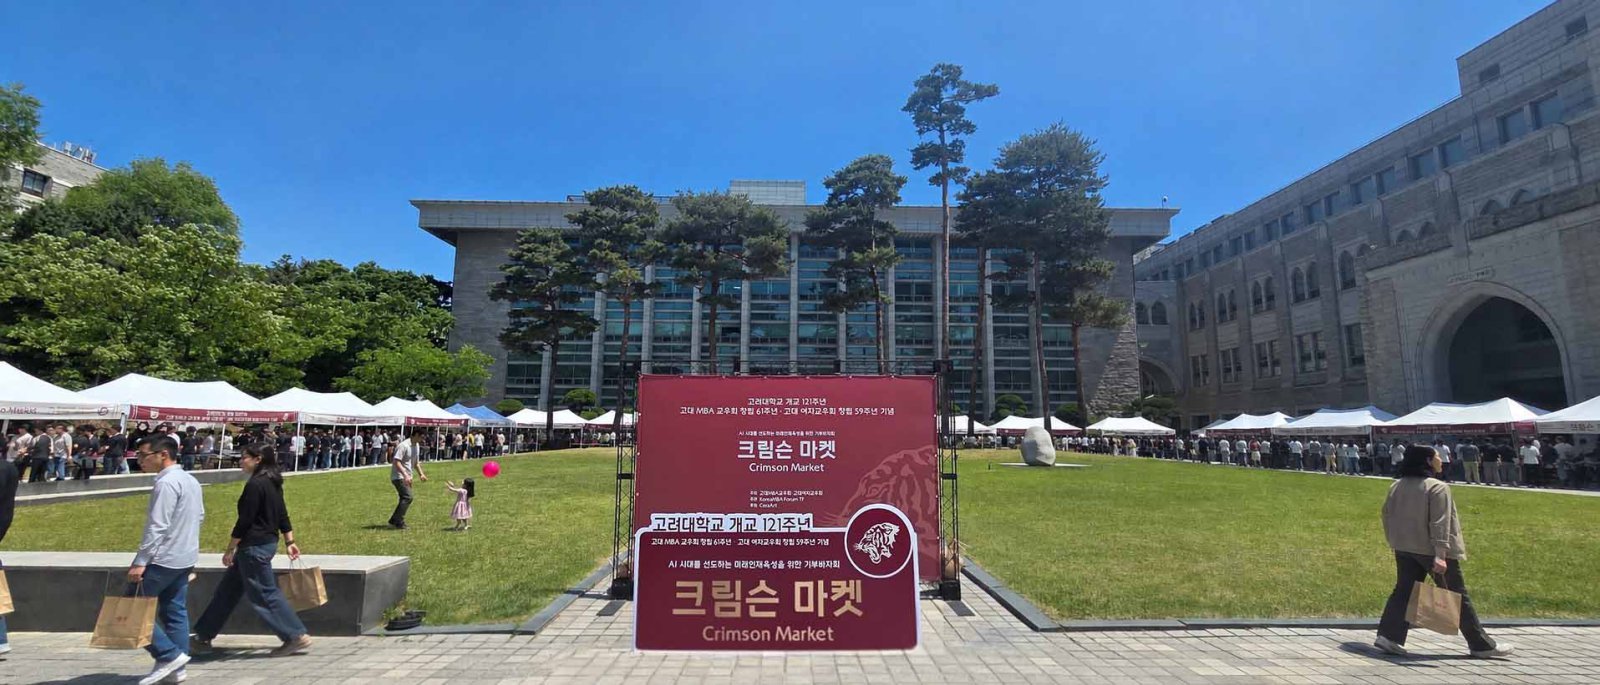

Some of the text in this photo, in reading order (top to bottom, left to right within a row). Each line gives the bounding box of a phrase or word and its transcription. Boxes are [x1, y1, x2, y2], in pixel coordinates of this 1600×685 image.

[747, 397, 827, 406] 고려대학교 개교 121주년
[679, 407, 695, 415] 고대
[695, 407, 715, 416] MBA
[716, 406, 738, 416] 교우회
[739, 406, 755, 416] 창립
[755, 406, 778, 416] 61주년
[783, 407, 799, 416] 고대
[800, 407, 837, 416] 여자교우회
[838, 407, 853, 416] 창립
[854, 407, 878, 416] 59주년
[880, 407, 895, 416] 기념
[737, 439, 837, 460] 크림슨 마켓
[748, 462, 825, 473] Crimson Market
[652, 516, 811, 533] 고려대학교 개교 121주년
[651, 537, 664, 547] 고대
[664, 538, 681, 546] MBA
[681, 538, 700, 547] 교우회
[700, 538, 713, 547] 창립
[713, 538, 732, 547] 61주년
[737, 538, 750, 547] 고대
[751, 538, 782, 547] 여자교우회
[782, 538, 795, 547] 창립
[795, 538, 816, 547] 59주년
[817, 538, 830, 547] 기념
[667, 559, 841, 570] AI 시대를 선도하는 미래인재육성을 위한 기부바자회
[671, 579, 864, 618] 크림슨 마켓
[702, 625, 835, 642] Crimson Market
